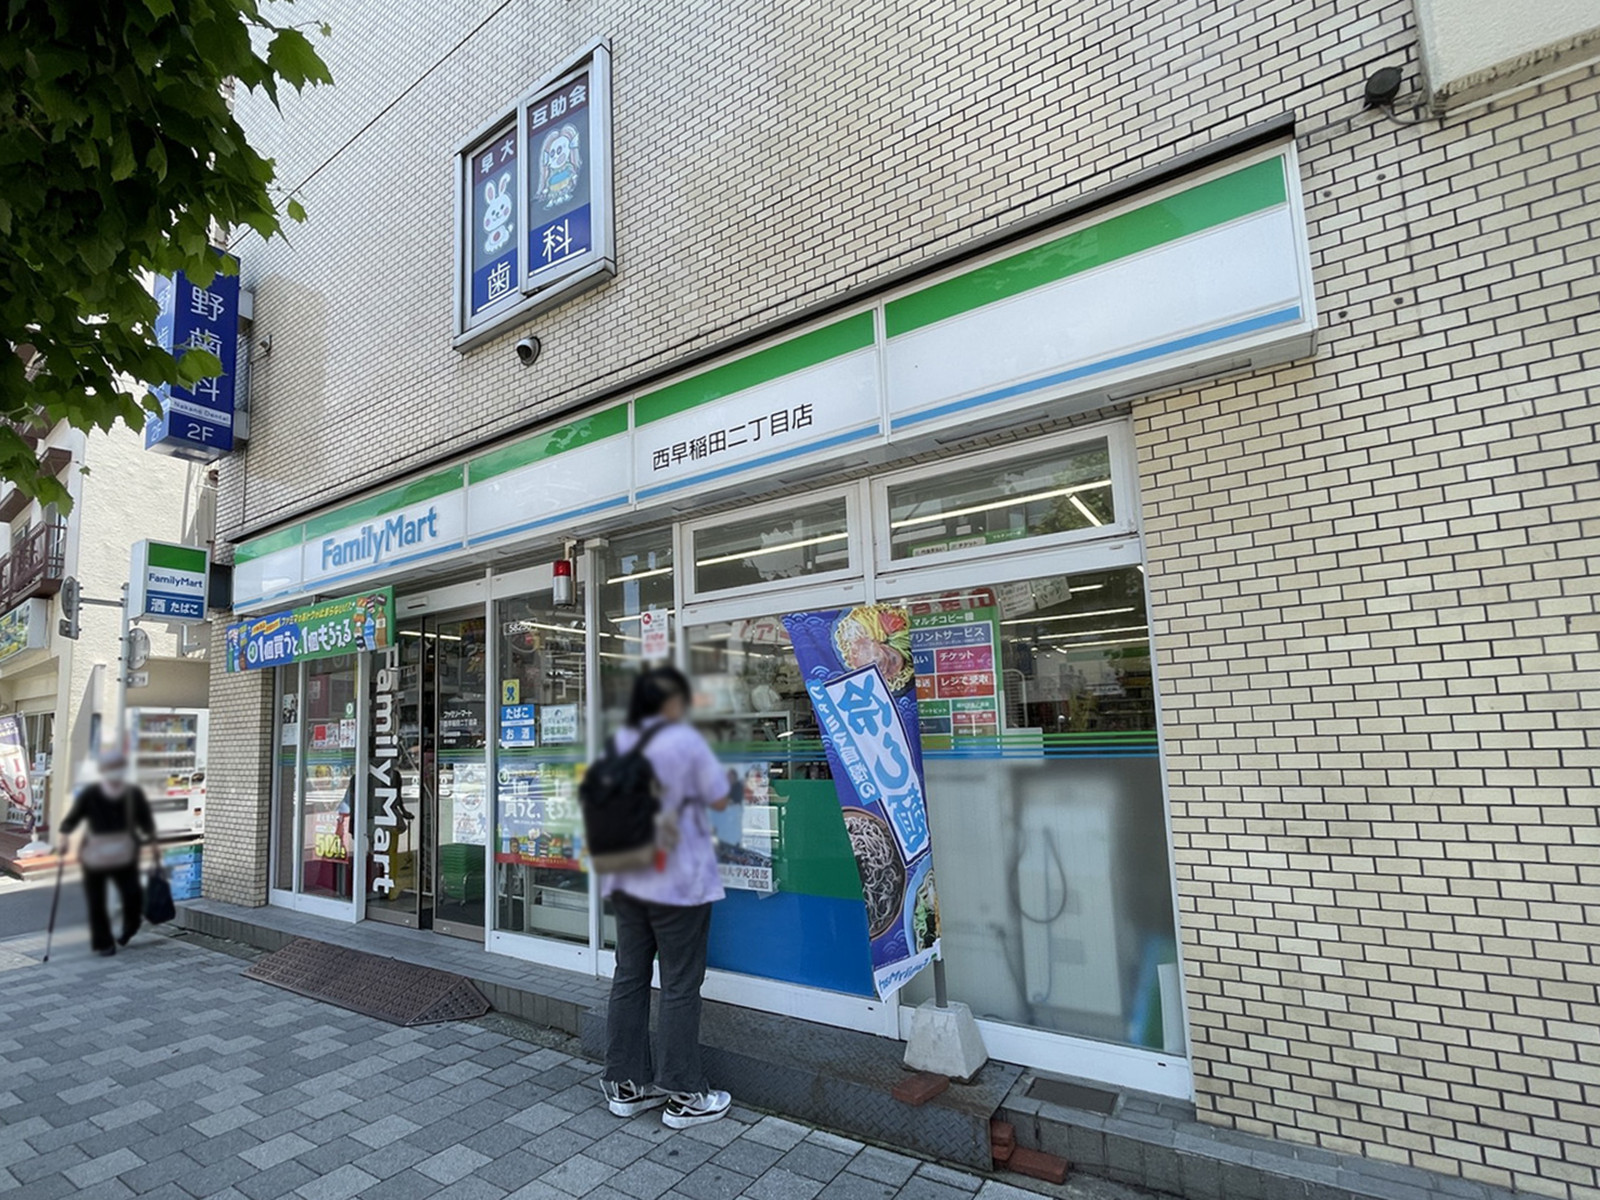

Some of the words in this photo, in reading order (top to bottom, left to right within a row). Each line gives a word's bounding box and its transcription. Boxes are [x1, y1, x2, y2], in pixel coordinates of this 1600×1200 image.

[480, 139, 515, 174] 早大
[531, 84, 588, 131] 互助会
[487, 260, 511, 301] 歯
[542, 218, 573, 263] 科
[174, 401, 202, 415] Nakano
[203, 408, 230, 421] Dental
[187, 422, 214, 441] 2F
[653, 403, 813, 471] 西早稲田二丁目店
[321, 506, 437, 571] FamilyMart
[148, 572, 203, 588] FamilyMart
[150, 598, 166, 613] 酒
[170, 602, 199, 615] たばこ
[913, 612, 974, 626] マルチコピー機
[940, 650, 974, 661] チケット
[505, 706, 530, 720] たばこ
[370, 643, 399, 895] FamilyMart
